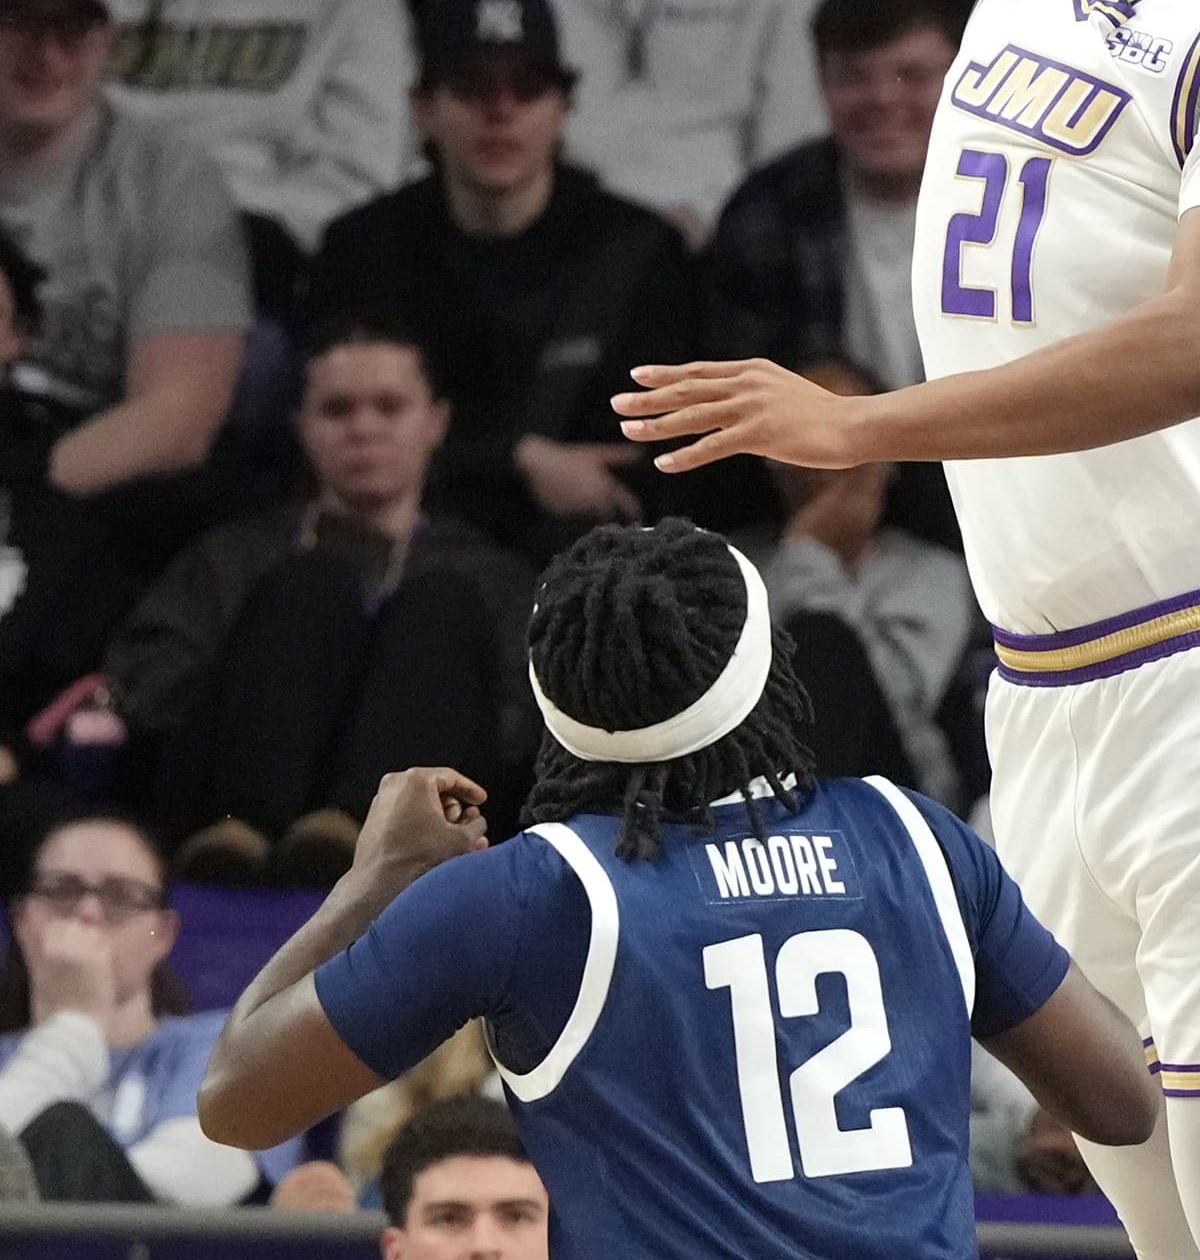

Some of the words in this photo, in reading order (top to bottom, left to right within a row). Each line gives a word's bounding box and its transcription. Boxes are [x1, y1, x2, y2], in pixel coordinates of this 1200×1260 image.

[952, 46, 1129, 154] JMU
[1104, 26, 1174, 74] SBC
[941, 147, 1055, 328] 21
[705, 836, 846, 899] MOORE
[702, 928, 913, 1183] 12
